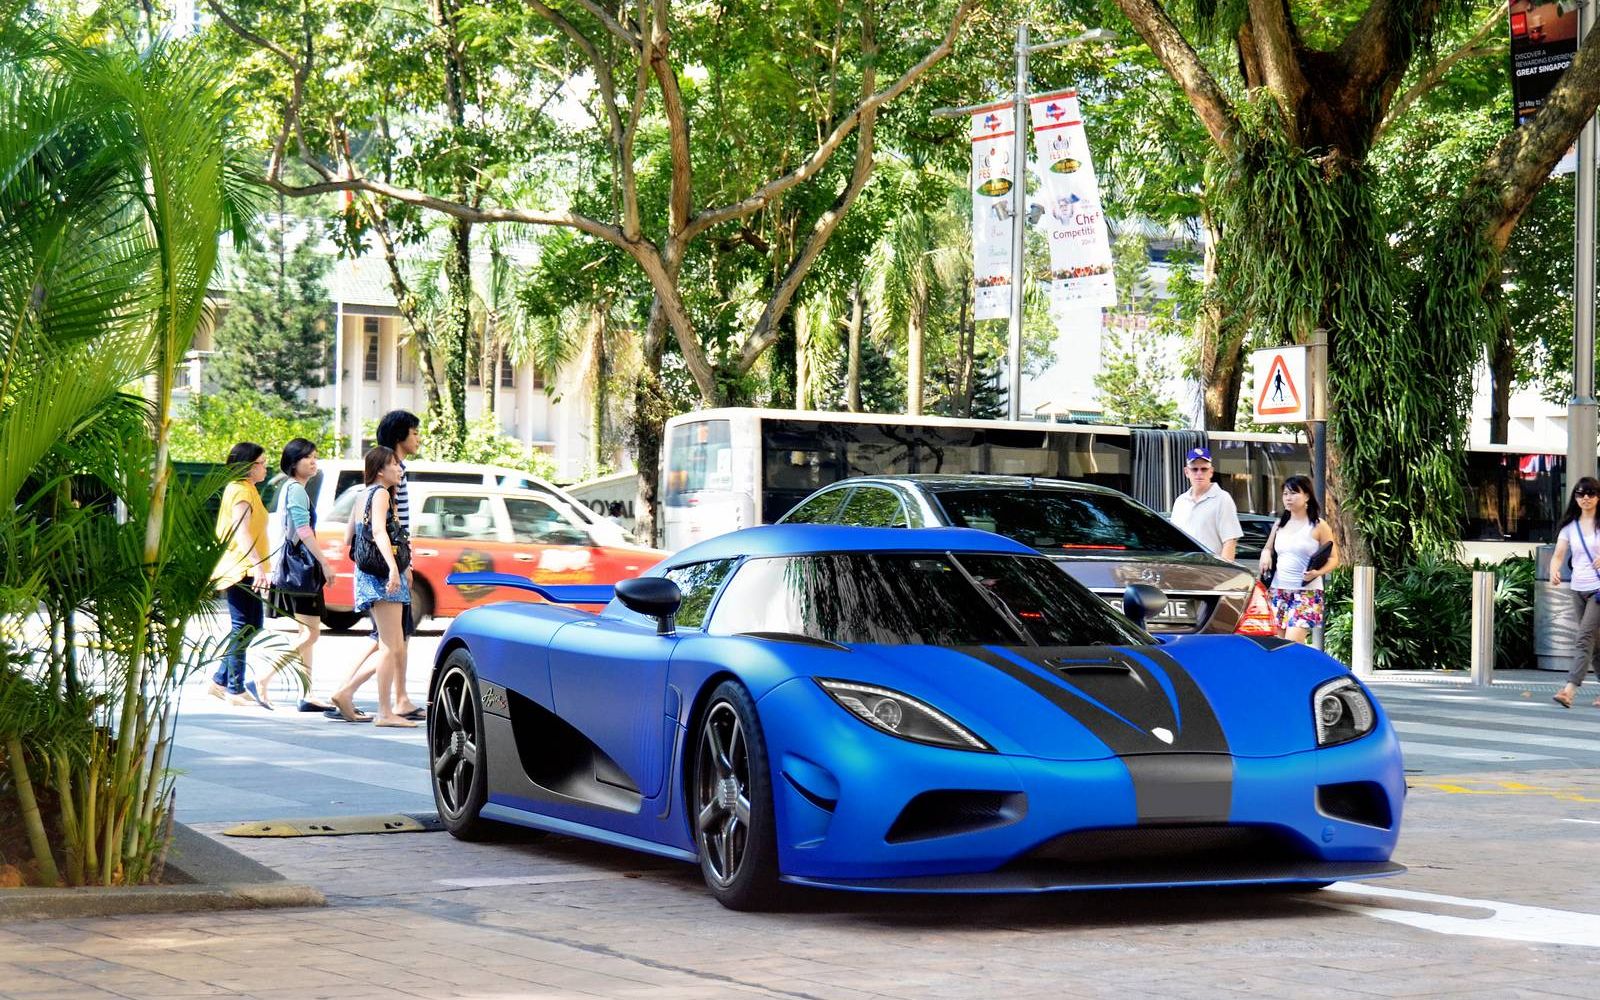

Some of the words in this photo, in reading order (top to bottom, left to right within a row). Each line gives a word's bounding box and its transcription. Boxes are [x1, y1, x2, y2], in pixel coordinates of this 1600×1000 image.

[1514, 50, 1542, 61] DISCOVER
[1548, 51, 1576, 63] EXPERIENC
[1516, 67, 1538, 77] GREAT
[1538, 61, 1571, 74] SINGAPOR
[1075, 211, 1099, 226] Chef
